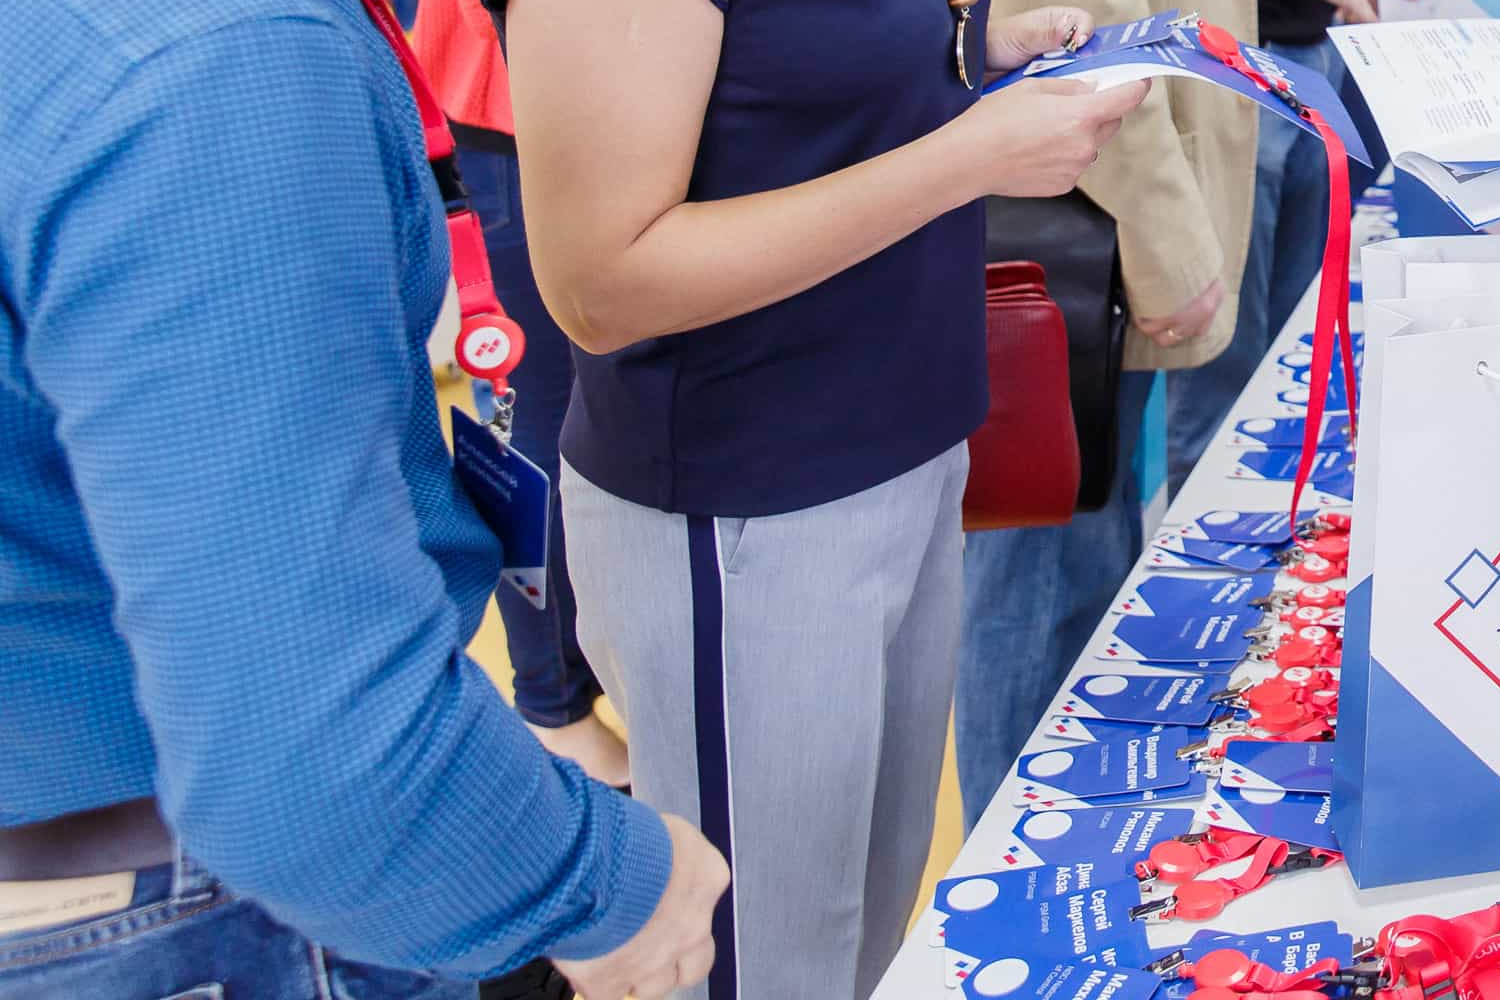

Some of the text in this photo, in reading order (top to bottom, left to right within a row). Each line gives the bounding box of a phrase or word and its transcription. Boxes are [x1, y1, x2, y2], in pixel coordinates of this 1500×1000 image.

[1144, 735, 1160, 780] Владимир
[1134, 811, 1165, 852] Михаил
[1055, 866, 1072, 895] Абза
[1066, 894, 1088, 955] Маркелов
[1089, 889, 1113, 931] Сергей
